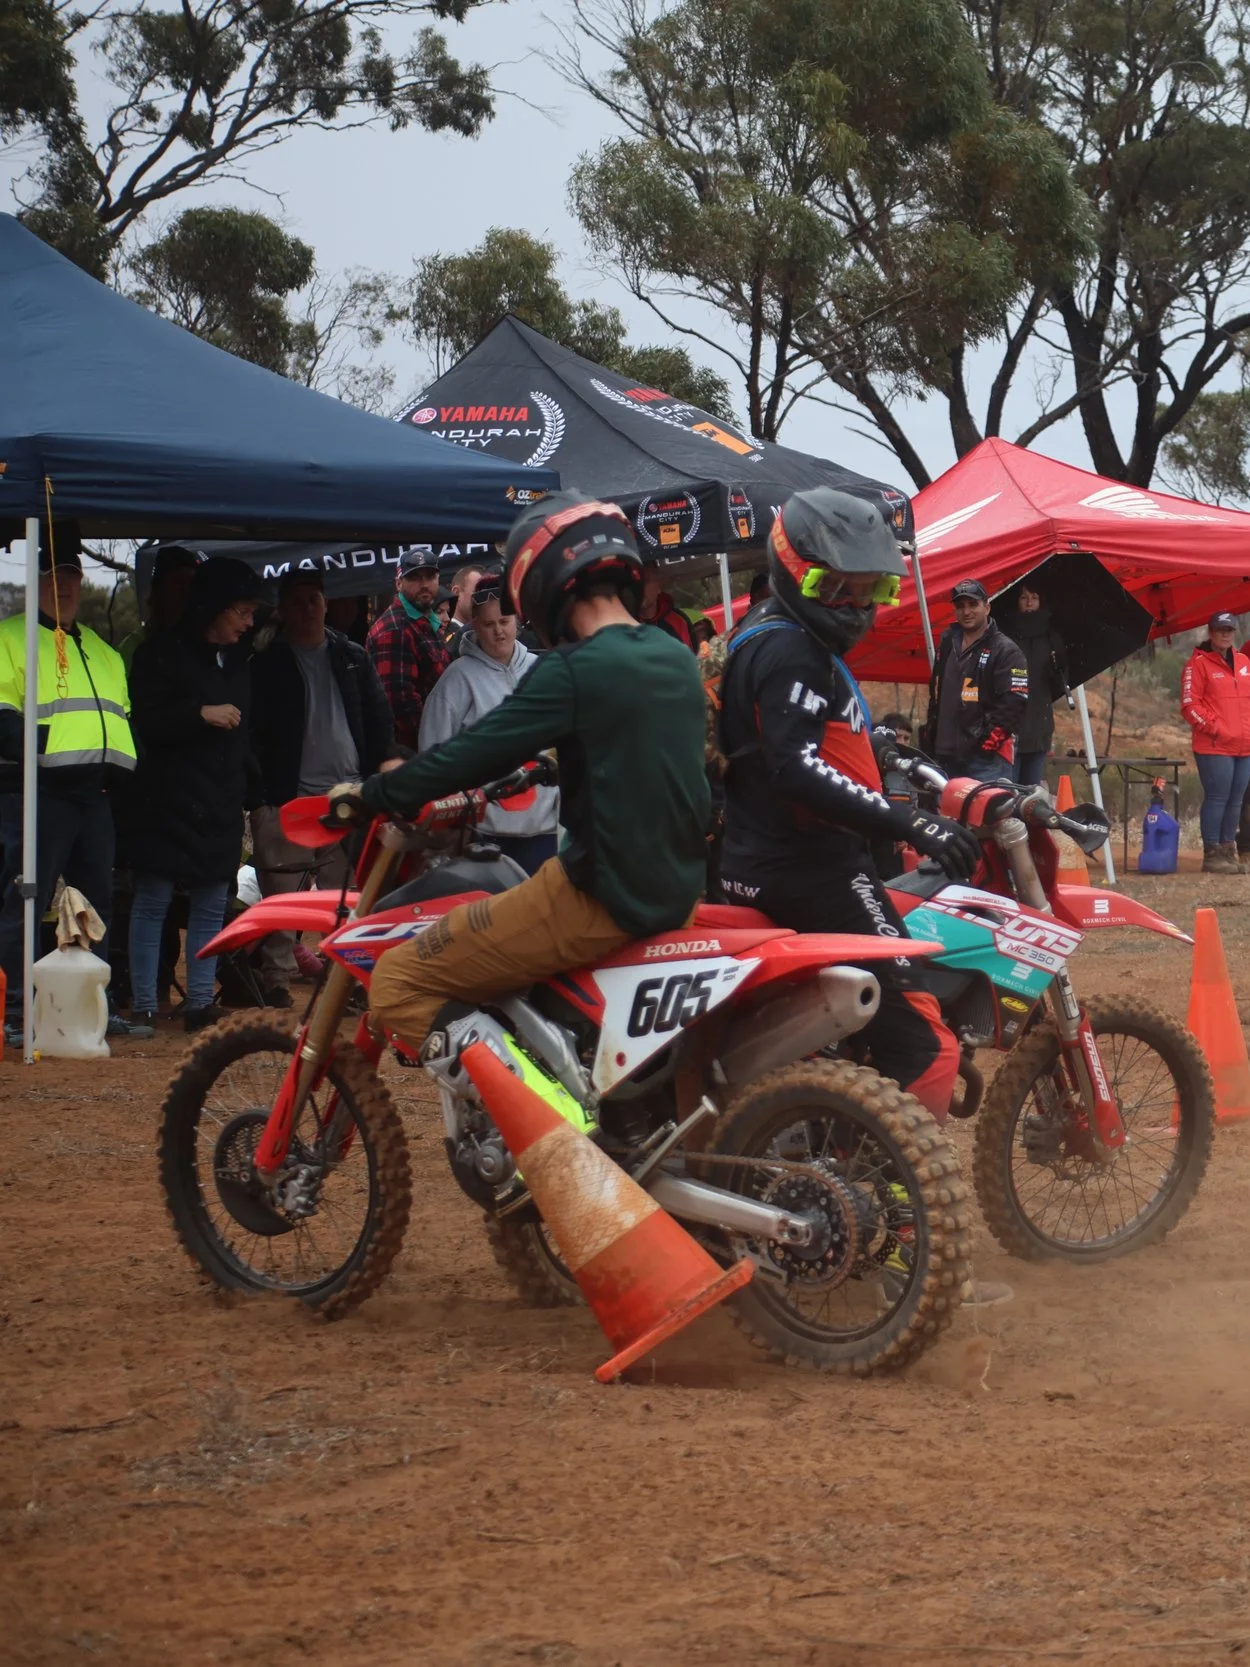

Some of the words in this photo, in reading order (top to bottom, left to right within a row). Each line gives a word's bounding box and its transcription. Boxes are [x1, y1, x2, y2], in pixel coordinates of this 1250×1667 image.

[440, 406, 530, 422] YAMAHA
[431, 428, 541, 438] NDURAH
[644, 510, 694, 520] MANDURAH
[912, 817, 953, 842] FOX
[643, 939, 722, 958] HONDA
[1006, 942, 1028, 956] MC
[1029, 950, 1056, 966] 350
[627, 968, 720, 1039] 605
